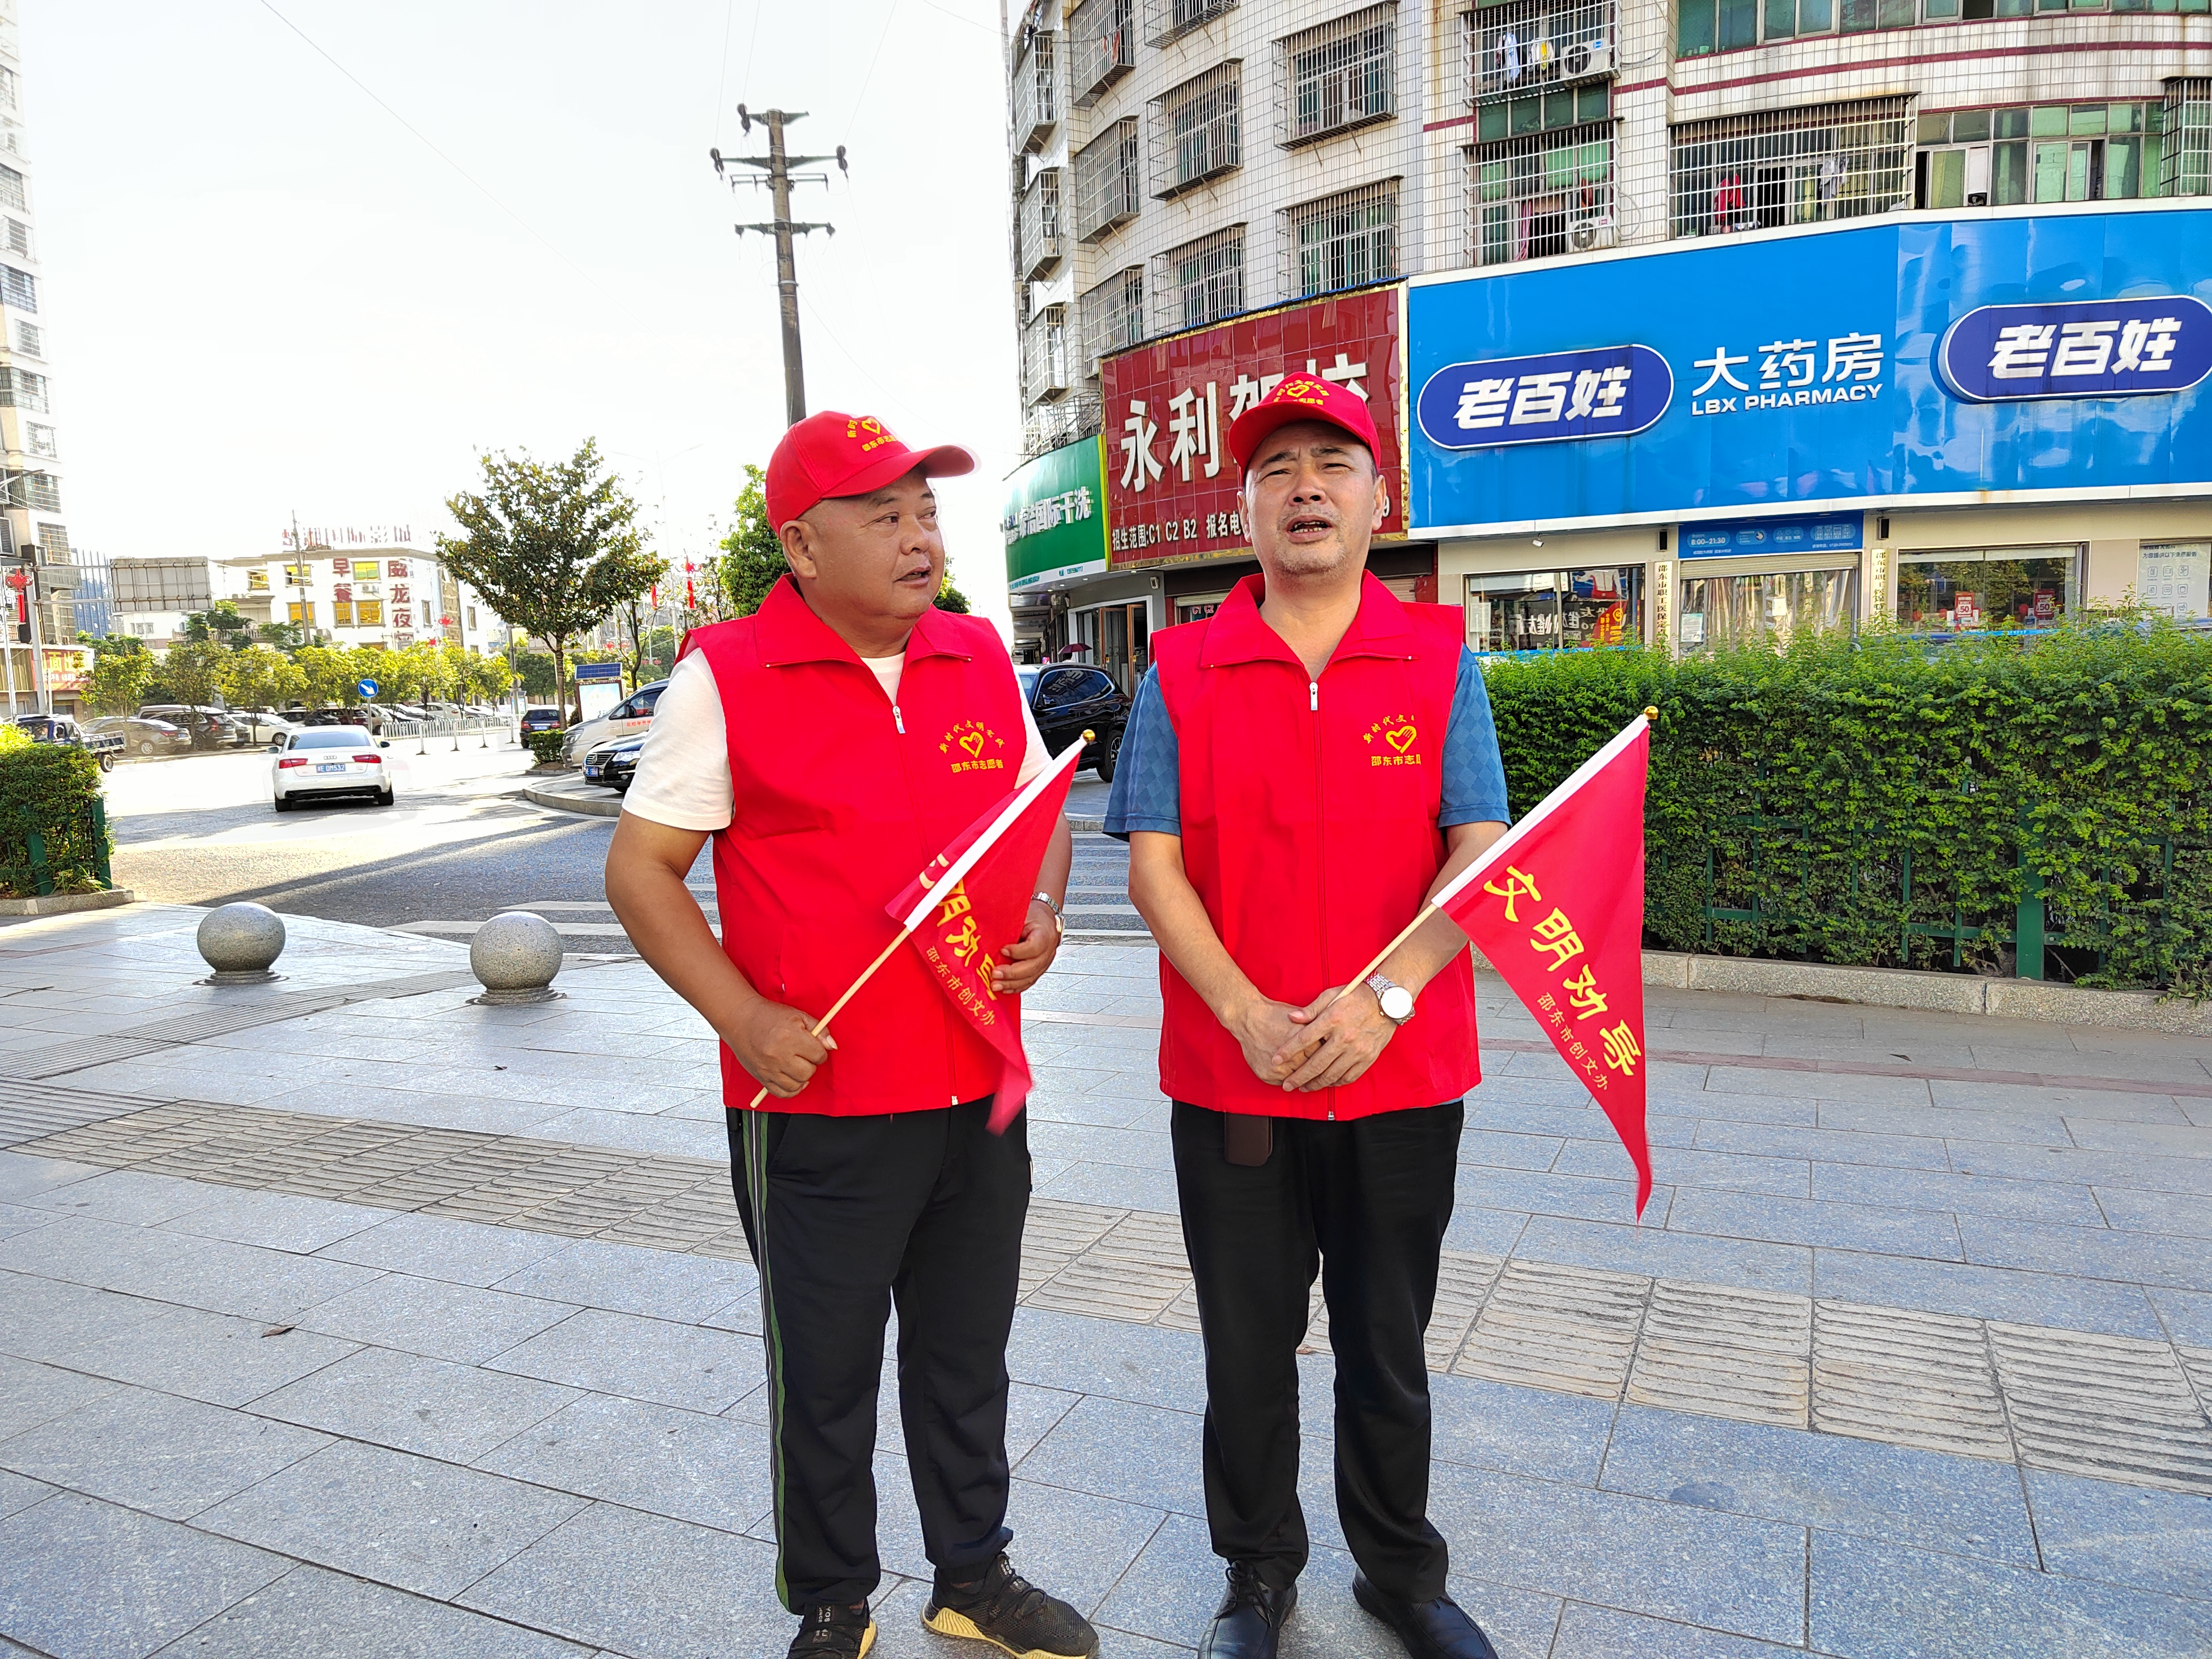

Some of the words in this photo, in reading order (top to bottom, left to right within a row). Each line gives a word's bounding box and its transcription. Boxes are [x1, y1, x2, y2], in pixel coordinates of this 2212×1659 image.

[1692, 332, 1883, 397] 大药房
[1988, 317, 2182, 380] 老百姓
[1453, 365, 1632, 430] 老百姓
[1692, 395, 1738, 416] LBX
[1745, 384, 1883, 411] PHARMACY
[1165, 521, 1179, 542] C2
[1183, 518, 1197, 539] B2
[1192, 605, 1201, 615] C1
[1204, 604, 1214, 614] C2
[950, 758, 1004, 773] 邵东市志愿者
[925, 945, 996, 1026] 邵东市创文办
[1483, 865, 1642, 1077] 文明劝导
[1537, 992, 1609, 1091] 邵东市创文办
